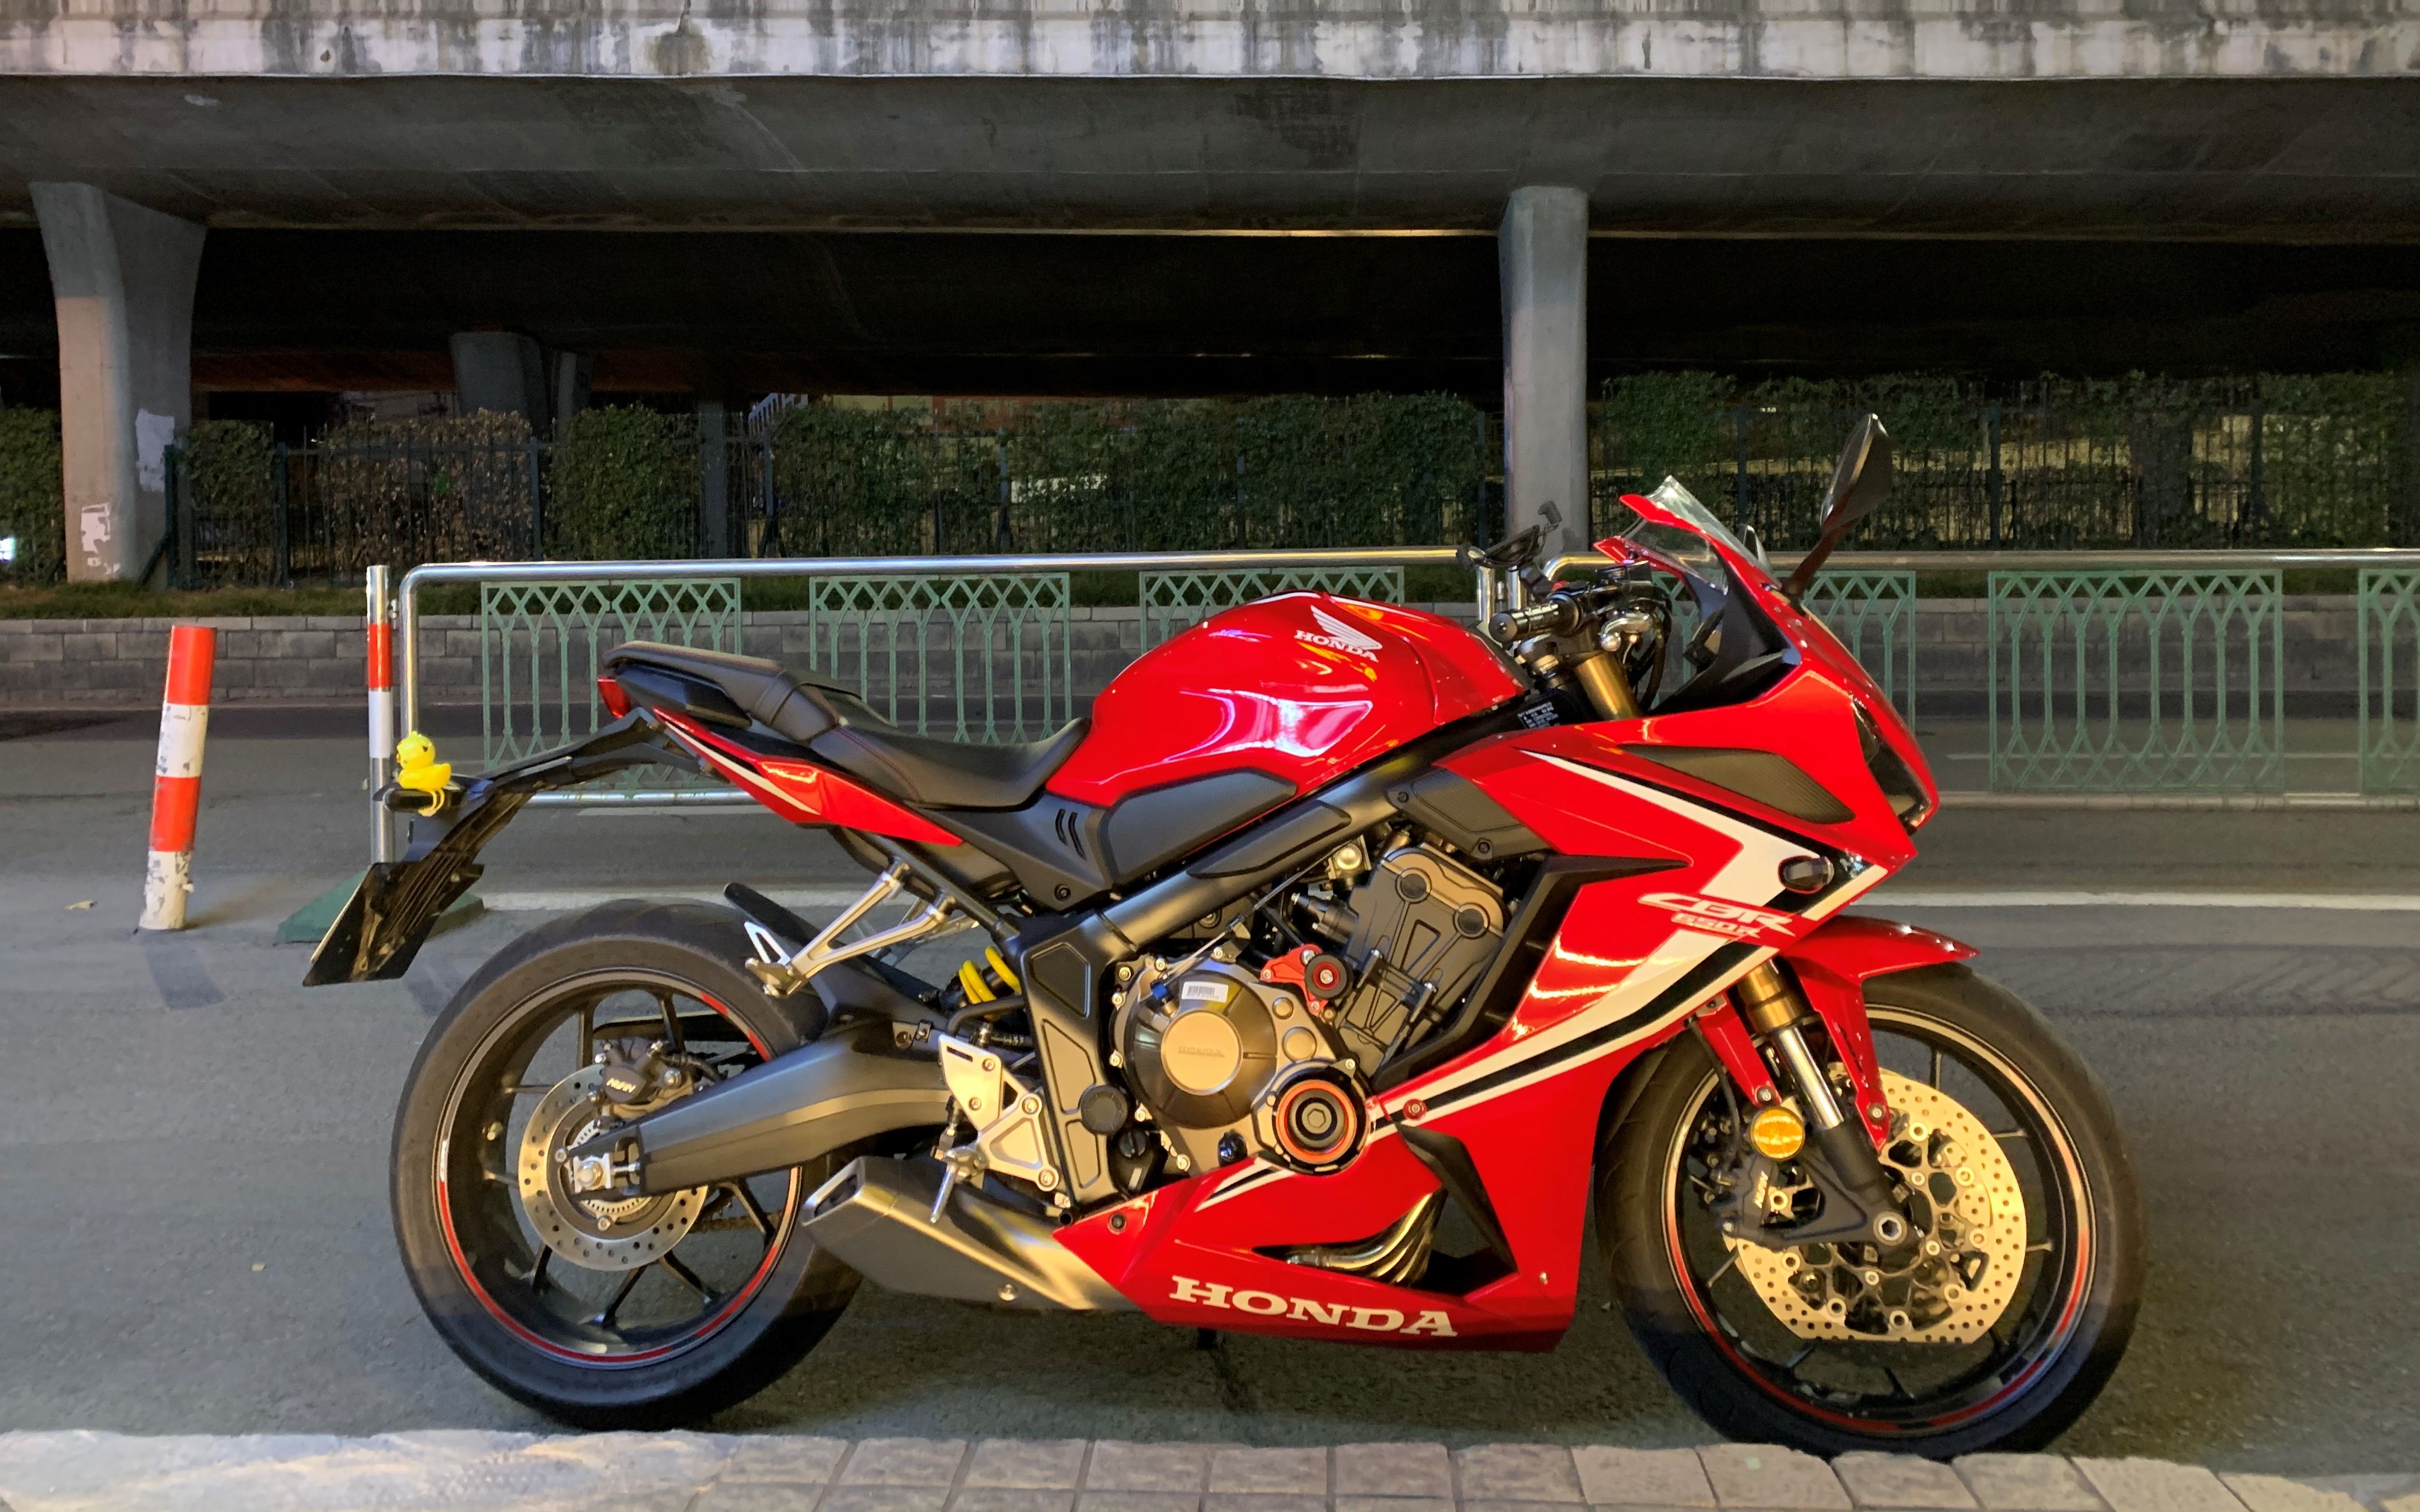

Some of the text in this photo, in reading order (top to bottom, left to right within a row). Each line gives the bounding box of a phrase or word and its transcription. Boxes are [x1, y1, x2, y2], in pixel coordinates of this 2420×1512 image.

[1294, 630, 1379, 663] HONDA
[1638, 893, 1796, 937] CBR
[1169, 1275, 1457, 1337] HONDA
